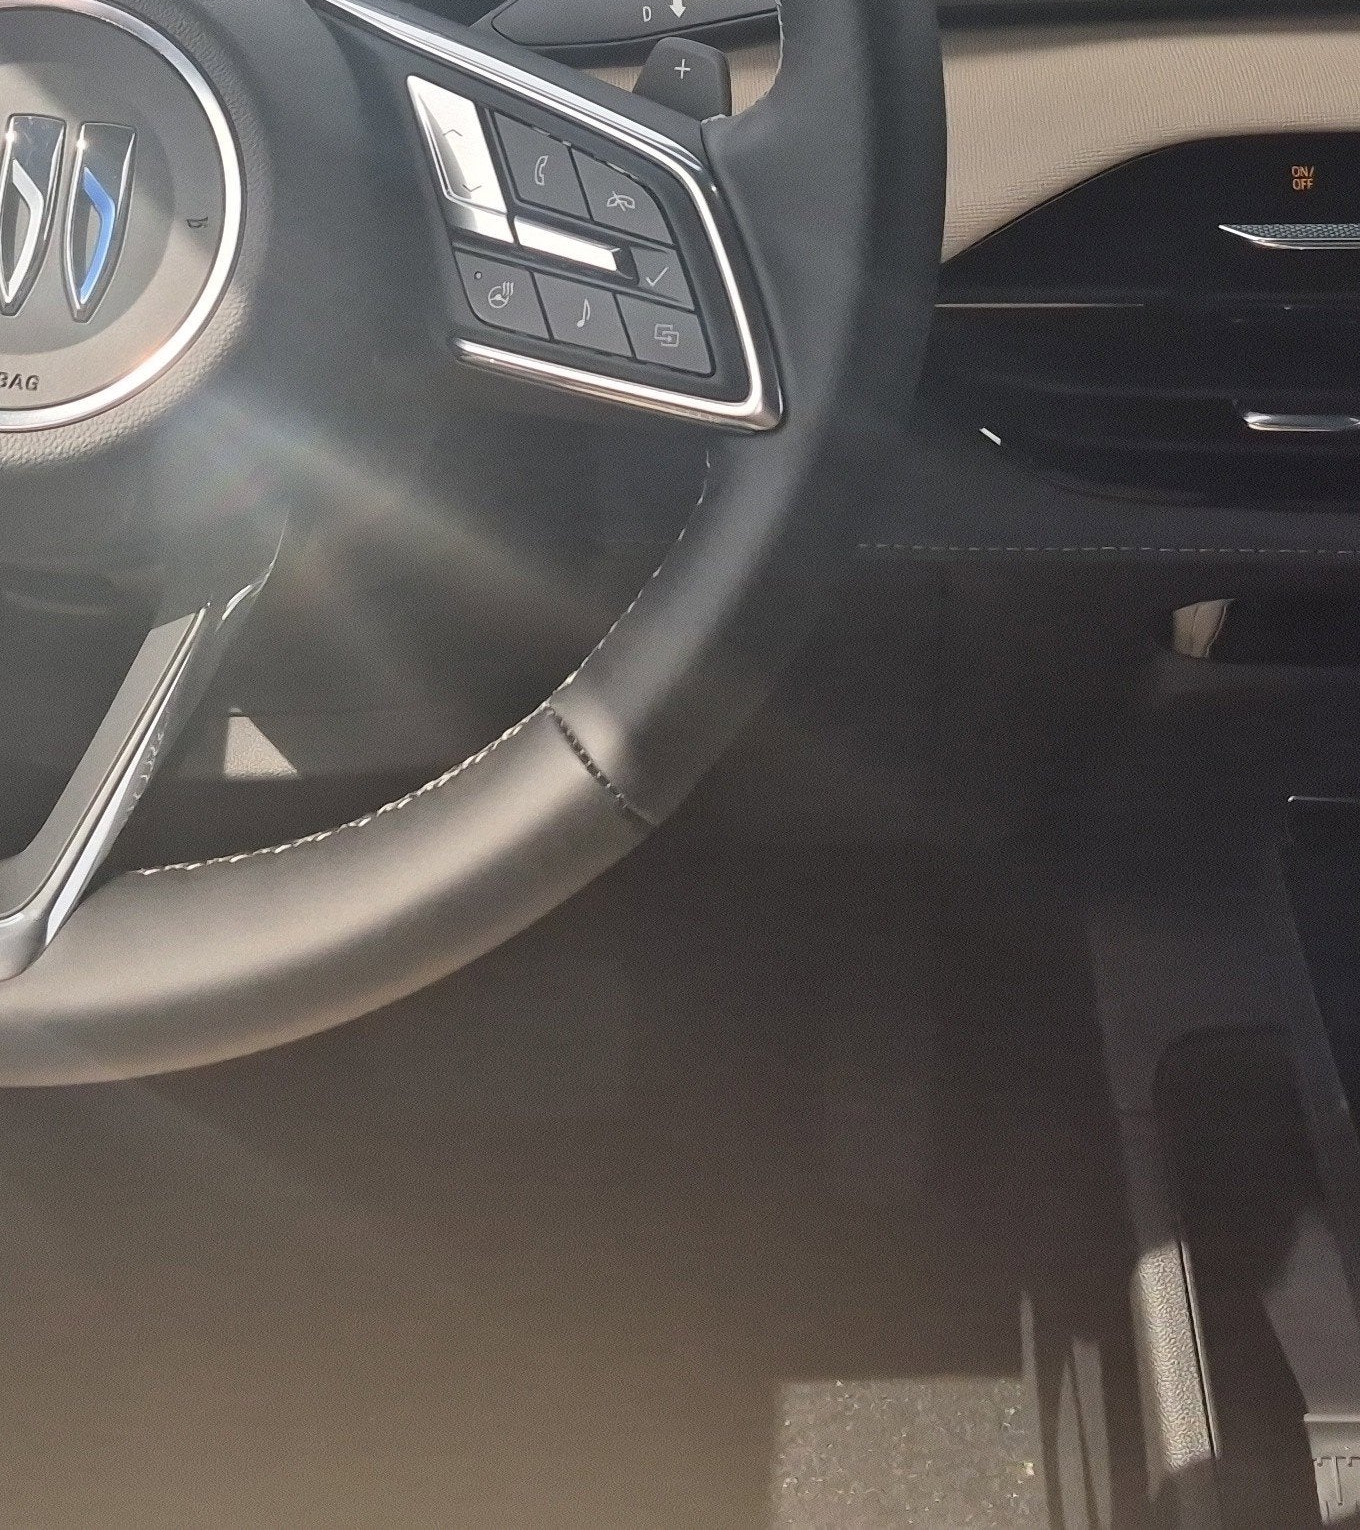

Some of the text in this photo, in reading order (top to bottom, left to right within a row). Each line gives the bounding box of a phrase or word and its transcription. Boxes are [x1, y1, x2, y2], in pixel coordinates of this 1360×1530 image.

[642, 6, 652, 22] D
[1291, 165, 1315, 178] ON/
[1292, 178, 1314, 191] OFF
